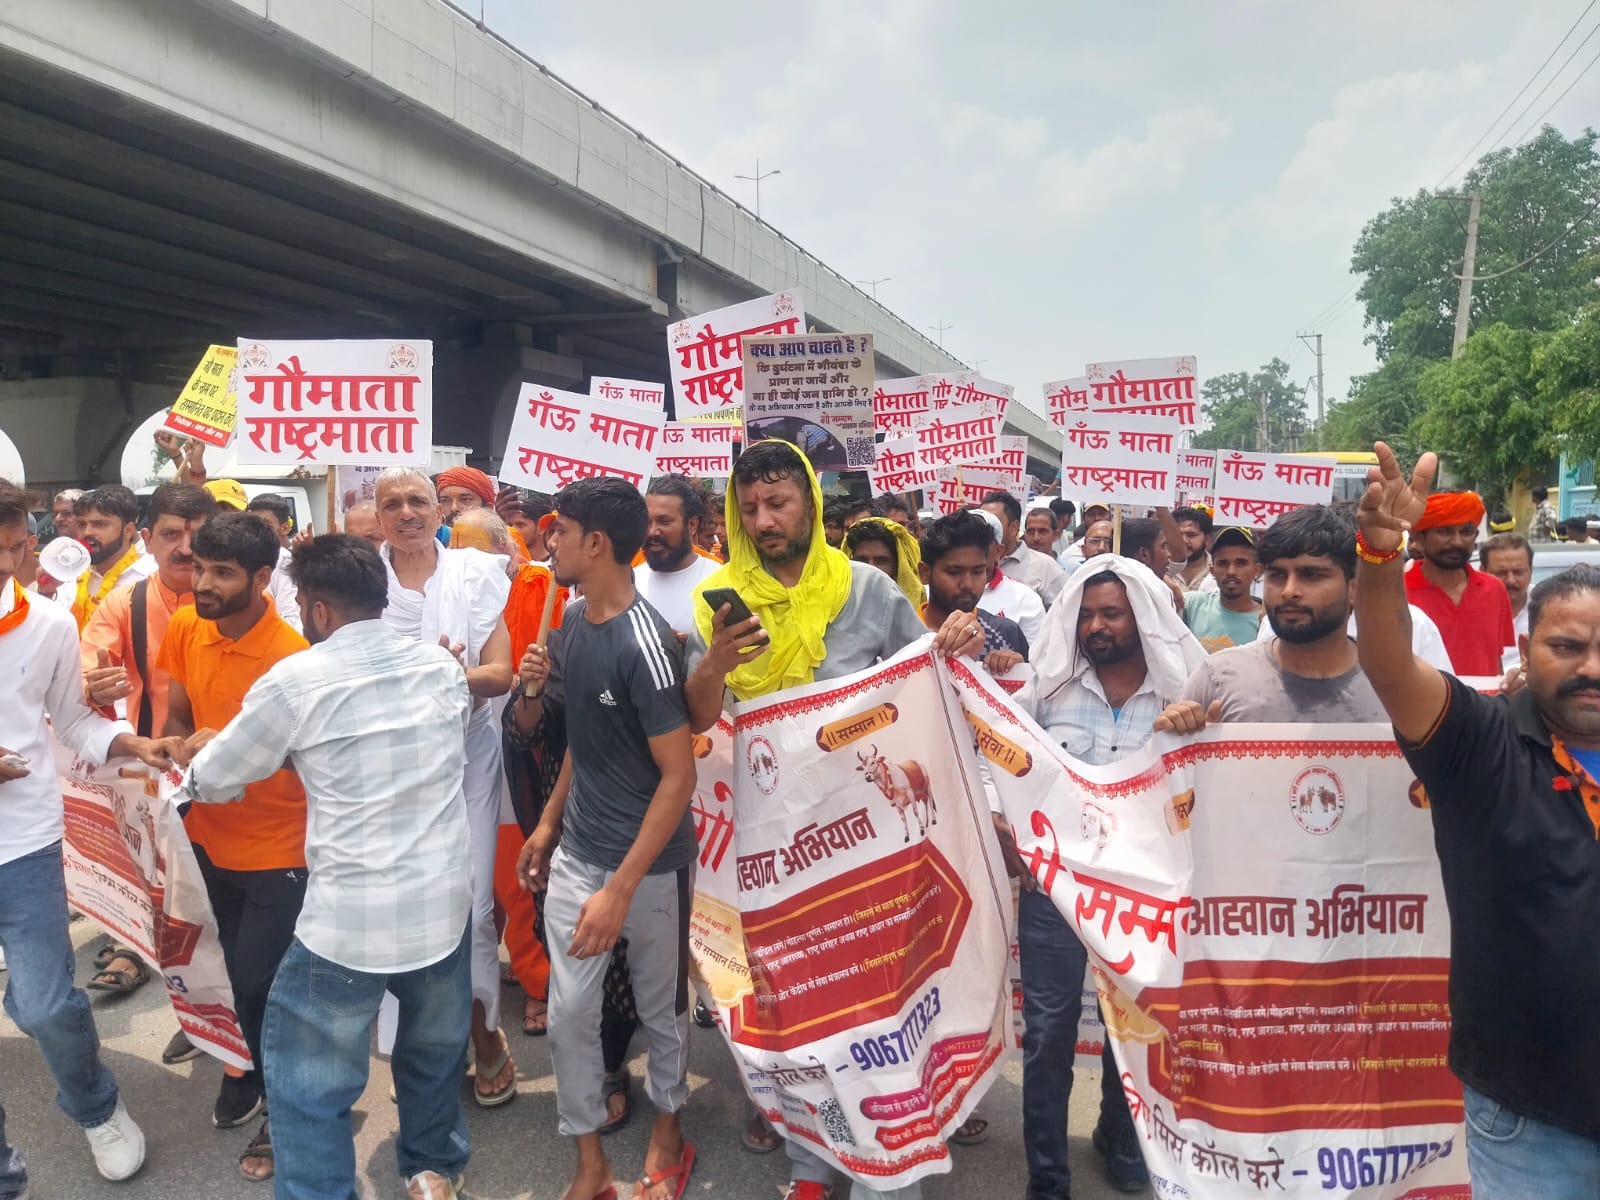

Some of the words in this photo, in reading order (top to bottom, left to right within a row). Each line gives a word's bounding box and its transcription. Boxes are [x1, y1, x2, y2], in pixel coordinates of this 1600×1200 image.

[750, 343, 776, 357] क्या
[779, 341, 806, 356] आप
[808, 338, 842, 354] चाहते
[860, 337, 868, 353] ?
[756, 361, 770, 373] कि
[851, 357, 862, 368] के
[769, 377, 790, 387] प्राण
[830, 372, 850, 384] और
[244, 355, 422, 412] गौमाता
[630, 389, 663, 404] माता
[767, 389, 778, 402] ही
[780, 388, 800, 401] कोई
[801, 390, 819, 399] जन
[822, 388, 845, 399] हानि
[847, 386, 858, 398] हो
[861, 388, 869, 397] ?
[1089, 369, 1195, 405] गौमाता
[528, 391, 581, 433] गँऊ
[589, 412, 659, 453] माता
[691, 427, 731, 443] माता
[916, 417, 995, 446] गौमाता
[245, 416, 421, 460] राष्ट्रमाता
[918, 436, 996, 465] राष्ट्रमाता
[1068, 420, 1110, 450] गँऊ
[1119, 431, 1173, 455] माता
[656, 455, 730, 476] राष्ट्रमाता
[1185, 455, 1214, 468] माता
[1223, 452, 1266, 482] गँऊ
[1275, 463, 1334, 487] माता
[1066, 466, 1168, 493] राष्ट्रमाता
[835, 716, 876, 740] सम्मान
[779, 806, 877, 876] अभियान
[1190, 896, 1297, 937] आह्वान
[1305, 884, 1428, 939] अभियान
[703, 945, 729, 967] सम्मान
[728, 956, 750, 977] दिवस
[1153, 1103, 1187, 1163] मिस
[1192, 1137, 1239, 1182] कॉल
